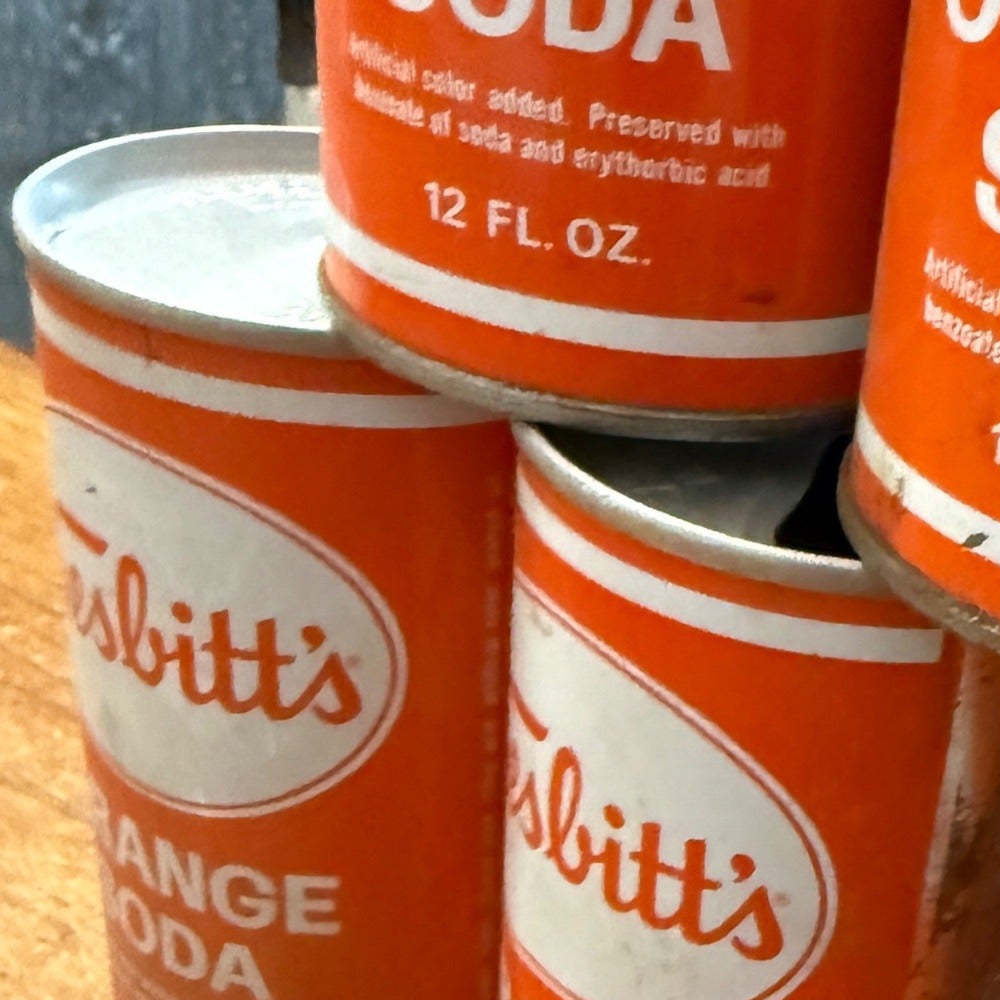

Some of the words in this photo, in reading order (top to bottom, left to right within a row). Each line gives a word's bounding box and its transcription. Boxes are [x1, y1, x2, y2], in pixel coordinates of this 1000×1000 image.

[458, 121, 512, 154] soda
[520, 138, 565, 164] and
[588, 101, 722, 146] Preserved
[733, 121, 787, 148] with
[424, 181, 467, 229] 12
[487, 199, 553, 250] FL.
[566, 217, 651, 266] OZ.
[108, 814, 342, 935] ANGE
